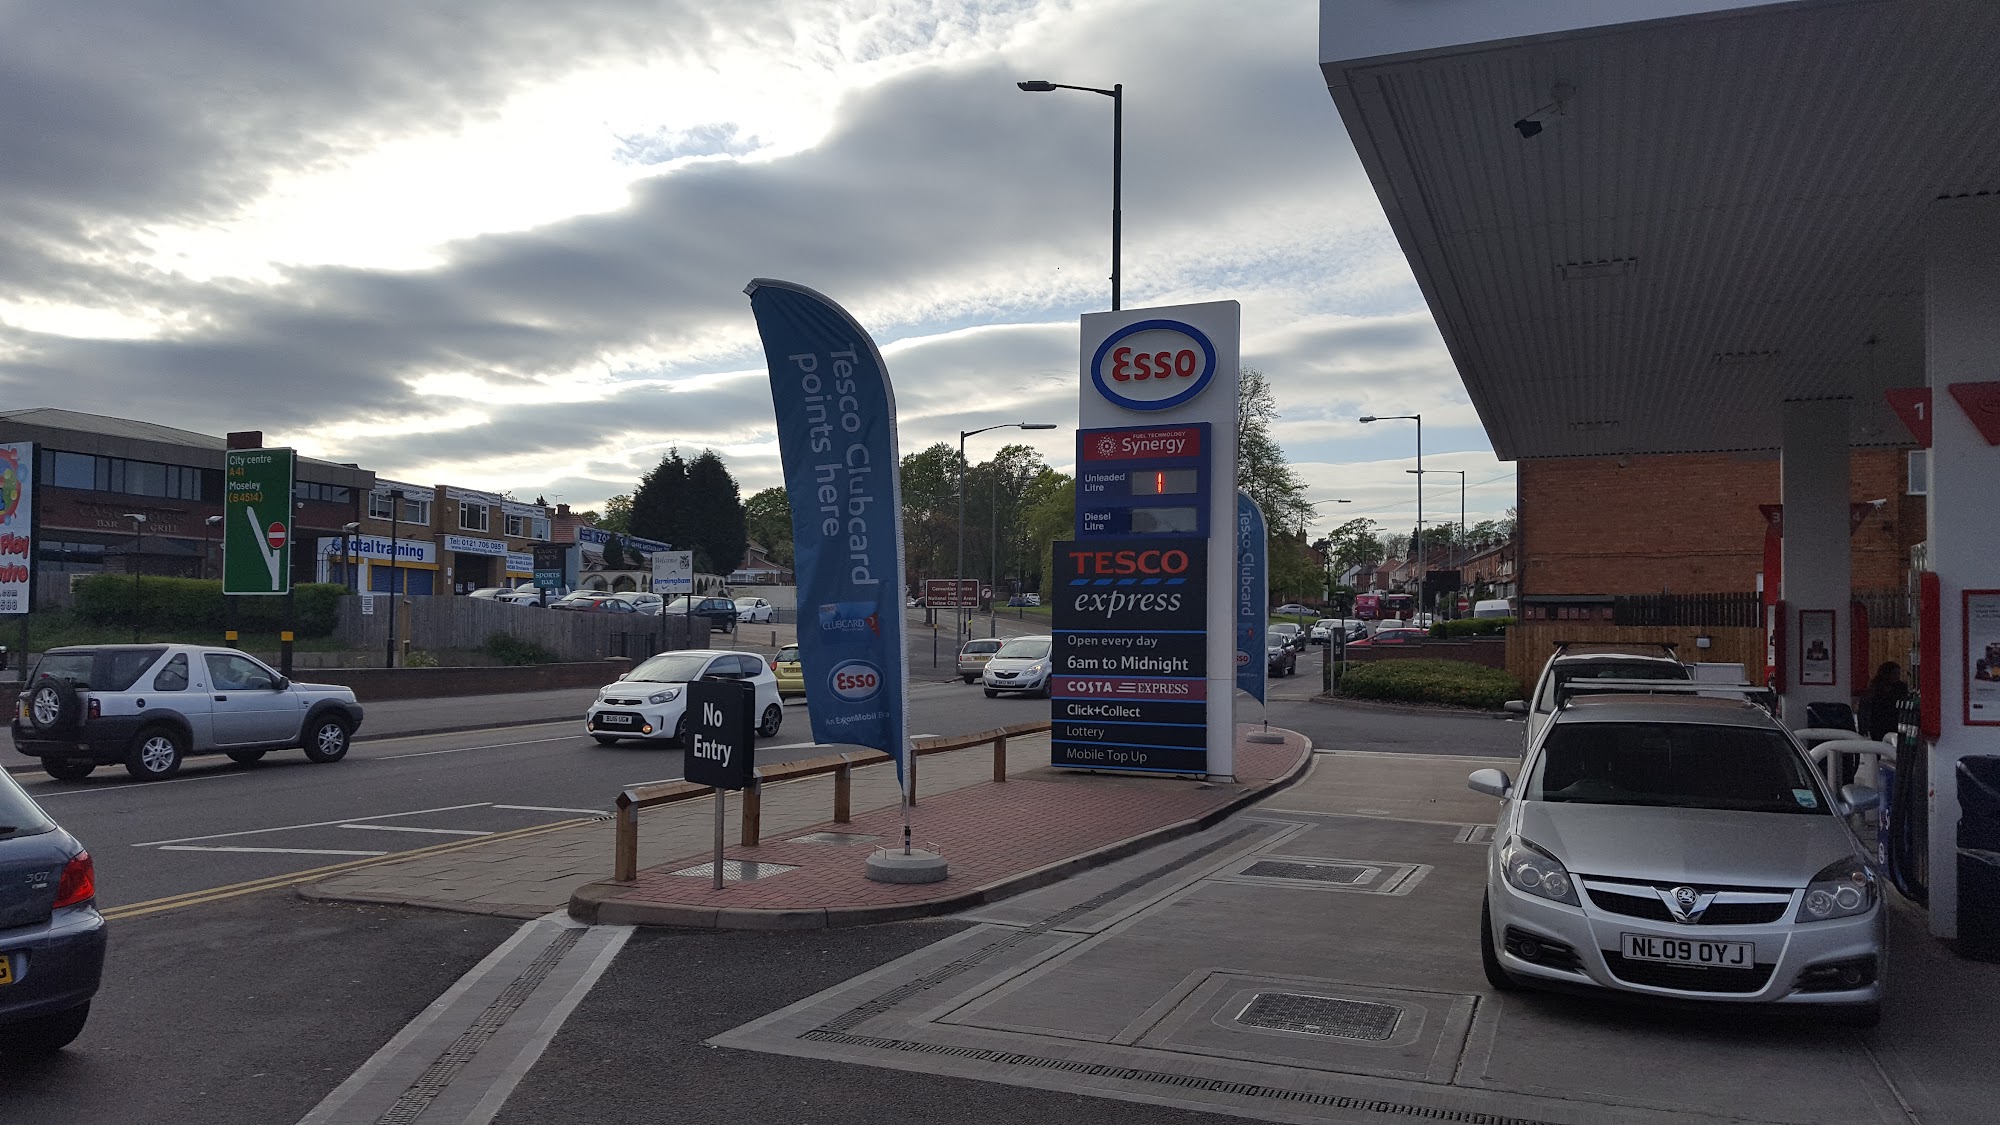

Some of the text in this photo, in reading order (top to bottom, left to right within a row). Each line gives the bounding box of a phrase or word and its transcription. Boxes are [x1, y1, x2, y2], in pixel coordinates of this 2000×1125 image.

[1112, 347, 1196, 382] Esso
[1914, 402, 1924, 420] 1
[788, 353, 842, 537] points here
[1121, 437, 1186, 455] Synergy
[229, 455, 272, 466] City centre
[830, 342, 879, 585] Tesco Clubcard
[1084, 473, 1125, 482] Unleaded
[229, 481, 261, 491] Moseley
[1084, 483, 1104, 492] Litre
[1084, 512, 1111, 521] Diesel
[1772, 512, 1780, 523] 3
[97, 519, 118, 528] BAR
[1084, 522, 1104, 531] Litre
[461, 539, 476, 547] 0121
[478, 540, 489, 548] 706
[490, 542, 504, 550] 0851
[1069, 549, 1189, 574] TESCO
[1239, 510, 1255, 616] Tesco Clubcard
[654, 577, 691, 585] Birmingham
[1074, 590, 1182, 619] express
[822, 619, 865, 630] CLUBCARD
[1067, 635, 1158, 648] Open every day
[1067, 655, 1189, 674] 6am to Midnight
[836, 672, 876, 690] Esso
[1067, 681, 1189, 694] COSTA EXPRESS
[703, 702, 723, 728] No
[1066, 704, 1141, 717] Click+Collect
[835, 712, 877, 725] ExxonMobil
[1066, 726, 1105, 739] Lottery
[693, 734, 732, 768] Entry
[1066, 748, 1148, 764] Mobile Top Up
[25, 871, 50, 883] 307
[1632, 937, 1692, 961] NL09
